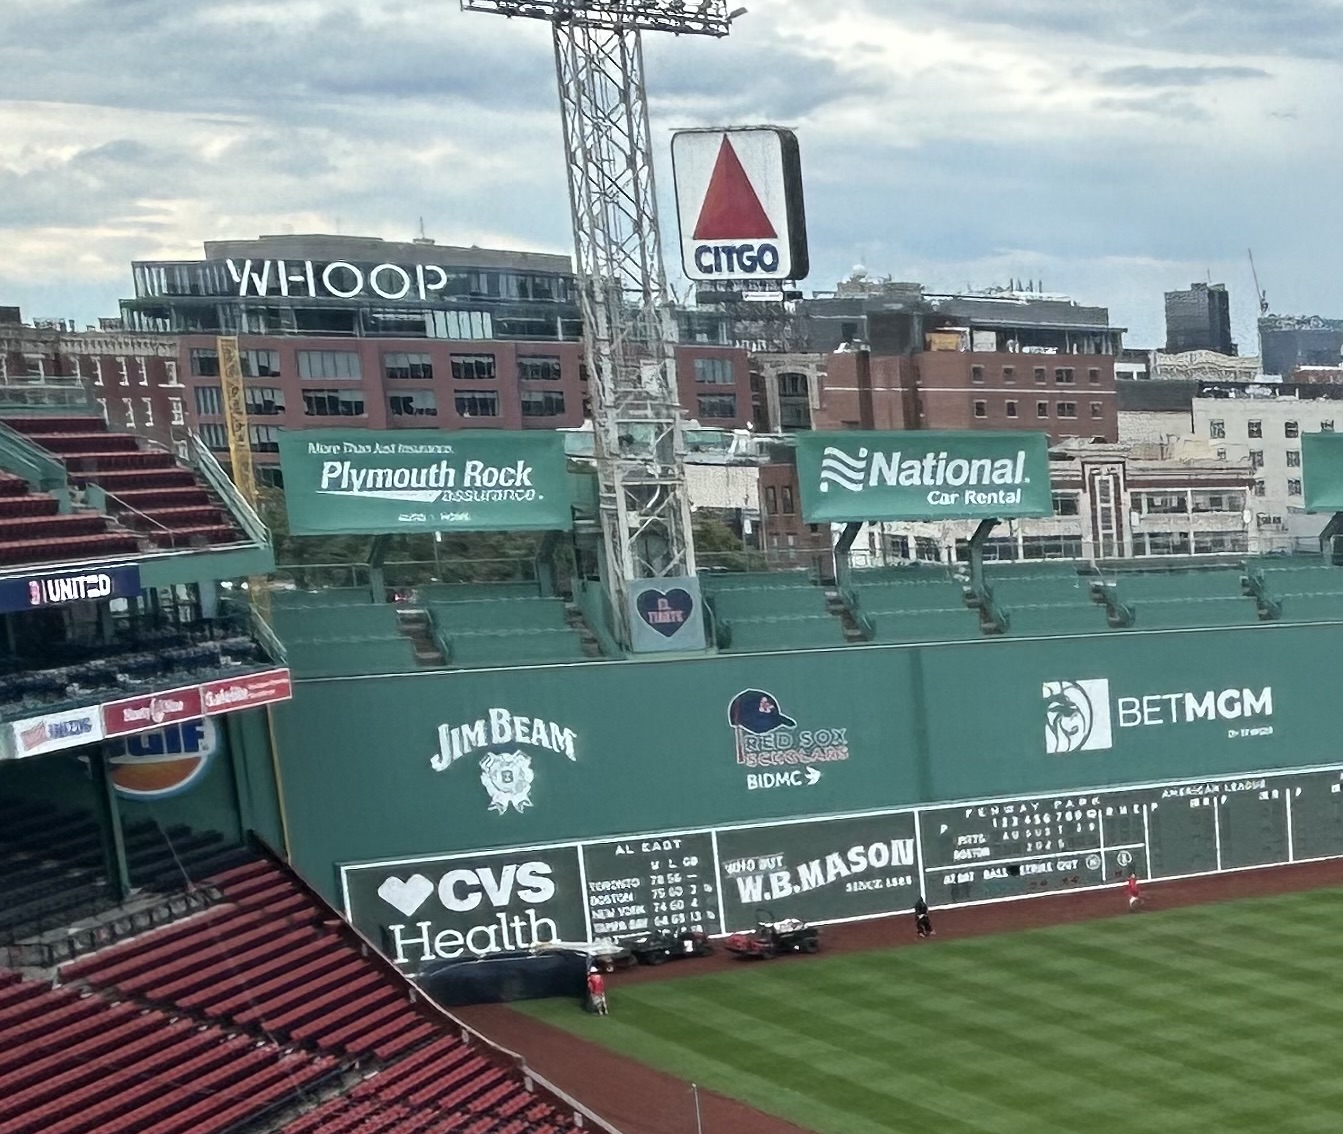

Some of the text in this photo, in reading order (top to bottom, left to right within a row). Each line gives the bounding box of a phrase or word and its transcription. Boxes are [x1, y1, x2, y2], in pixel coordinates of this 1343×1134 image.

[694, 243, 779, 274] CITGO
[226, 258, 448, 300] WHOOP
[320, 459, 533, 492] Plymouth Rock
[868, 449, 1026, 487] National
[926, 488, 1021, 505] Car Rental
[47, 573, 111, 602] UNITED
[1117, 686, 1274, 727] BETMGM
[430, 707, 579, 773] JIM BEAM
[744, 727, 849, 751] RED SOX
[746, 769, 803, 790] BIDMC
[965, 796, 1101, 819] FENWAY PARK
[615, 844, 635, 856] AL
[668, 858, 678, 869] L
[724, 854, 785, 874] WHO BUT
[983, 867, 1009, 880] BALL
[437, 861, 555, 912] CVS
[588, 877, 641, 892] TORONTO
[590, 892, 634, 907] BOSTON
[617, 904, 647, 917] YORK
[388, 908, 562, 964] Health
